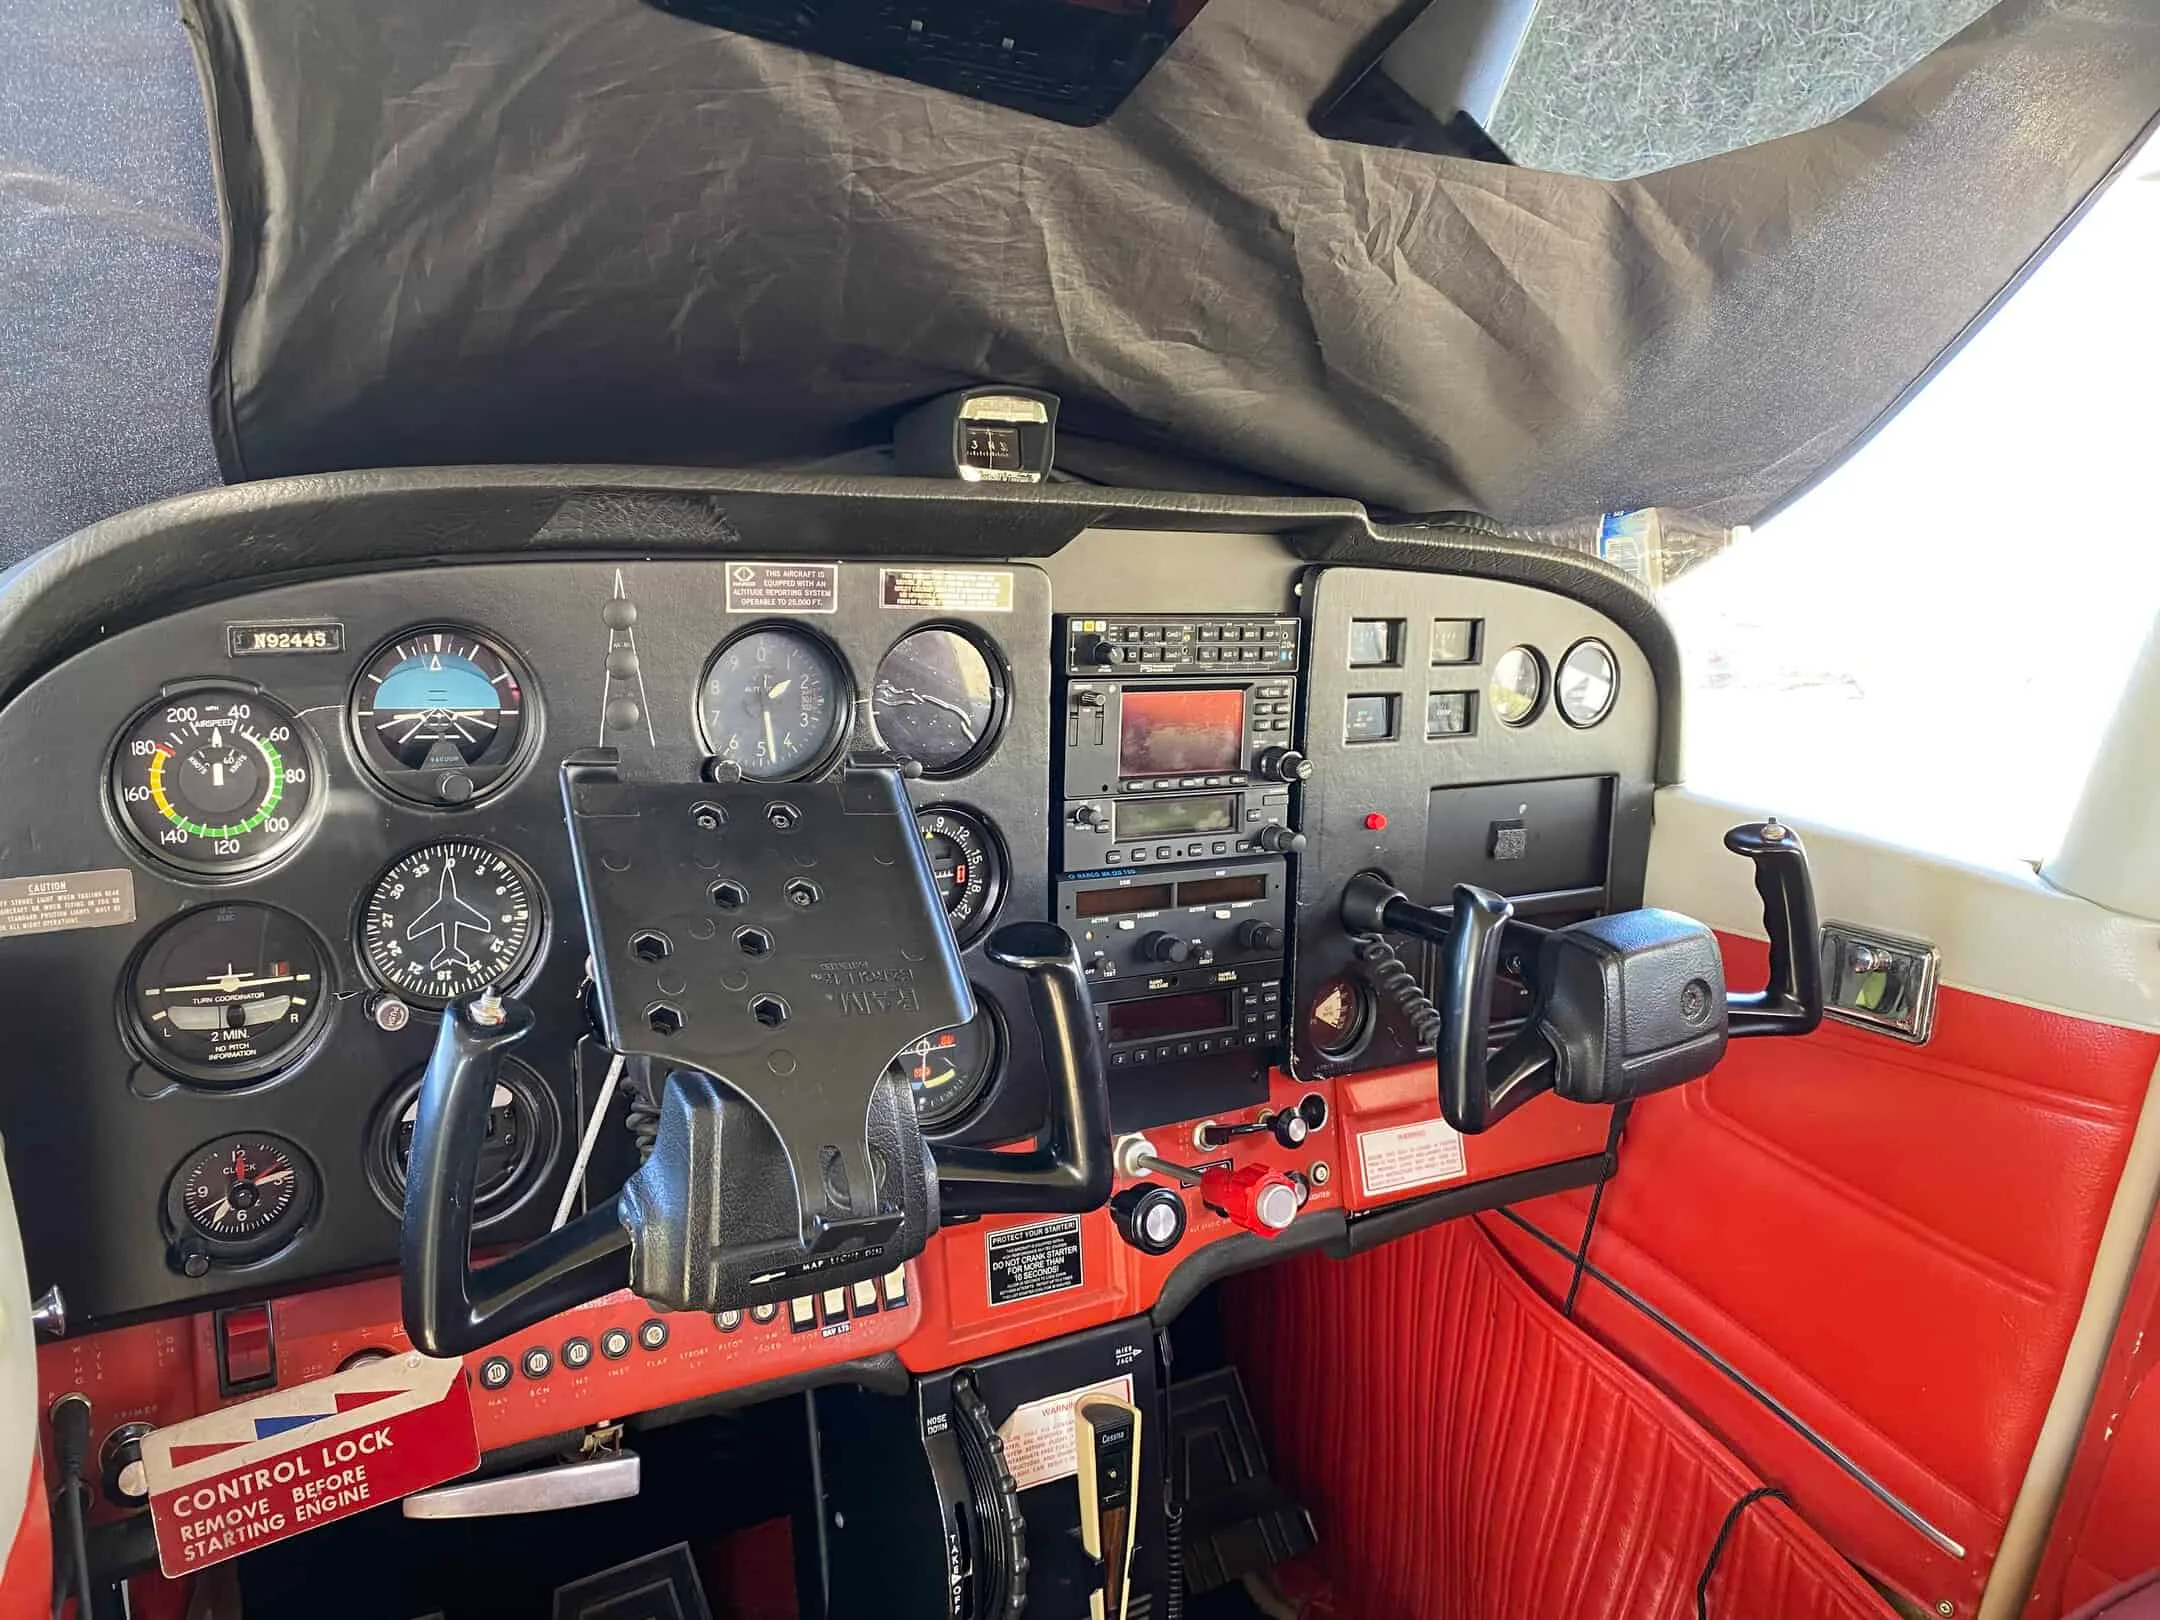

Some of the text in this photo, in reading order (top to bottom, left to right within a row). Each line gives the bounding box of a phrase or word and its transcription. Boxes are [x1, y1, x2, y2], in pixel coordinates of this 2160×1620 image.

[783, 570, 817, 578] AIRCRAFT
[254, 633, 326, 648] N92445
[757, 647, 766, 662] 0
[730, 655, 738, 672] 9
[710, 680, 720, 695] 8
[800, 674, 809, 689] 2
[166, 706, 198, 722] 200
[228, 704, 250, 720] 40
[711, 710, 721, 727] 7
[800, 712, 808, 727] 3
[195, 718, 234, 728] AIRSPEED
[270, 726, 290, 741] 60
[783, 732, 792, 746] 4
[131, 740, 155, 756] 180
[728, 734, 739, 749] 6
[756, 742, 765, 757] 5
[286, 769, 306, 784] 80
[124, 786, 150, 802] 160
[264, 817, 290, 833] 100
[936, 817, 945, 828] 9
[160, 830, 188, 846] 140
[957, 825, 970, 838] 12
[214, 840, 240, 856] 120
[970, 849, 984, 864] 15
[412, 864, 430, 878] 33
[475, 864, 486, 876] 3
[28, 880, 67, 894] CAUTION
[390, 883, 406, 900] 30
[496, 885, 507, 896] 6
[971, 879, 983, 894] 18
[58, 894, 76, 902] WHEN
[502, 914, 513, 923] 9
[958, 904, 972, 920] 21
[382, 912, 394, 928] 27
[387, 940, 403, 957] 24
[490, 938, 504, 953] 12
[408, 961, 425, 976] 21
[466, 959, 483, 974] 15
[436, 970, 452, 981] 18
[192, 992, 265, 1006] TURN COORDINATOR
[290, 1014, 299, 1023] R
[164, 1028, 172, 1038] L
[210, 1029, 250, 1042] 2 MIN.
[208, 1049, 257, 1061] INFORMATION
[215, 1042, 250, 1053] NO PITCH
[222, 1162, 256, 1175] CLCK
[197, 1185, 208, 1198] 9
[236, 1209, 248, 1221] 6
[992, 1221, 1076, 1245] PROTECT YOUR STARTER!
[802, 1258, 824, 1272] MAP
[992, 1261, 1004, 1271] DO
[1005, 1258, 1020, 1267] NOT
[1021, 1252, 1046, 1264] CRANK
[1046, 1246, 1078, 1258] STARTER
[1008, 1256, 1064, 1276] FOR MORE THAN
[1014, 1264, 1059, 1282] 10 SECONDS!
[822, 1327, 837, 1338] NAV
[574, 1348, 584, 1358] 10
[534, 1358, 544, 1368] 10
[1116, 1356, 1134, 1366] JACK
[492, 1368, 501, 1379] 10
[926, 1413, 948, 1427] NOSE
[927, 1422, 948, 1436] DOWN
[1102, 1430, 1125, 1444] Cessna
[173, 1426, 394, 1518] CONTROL LOCK
[180, 1465, 368, 1543] REMOVE BEFORE
[184, 1482, 371, 1563] STARTING ENGINE
[950, 1534, 961, 1575] TAKE
[952, 1585, 962, 1615] OFF
